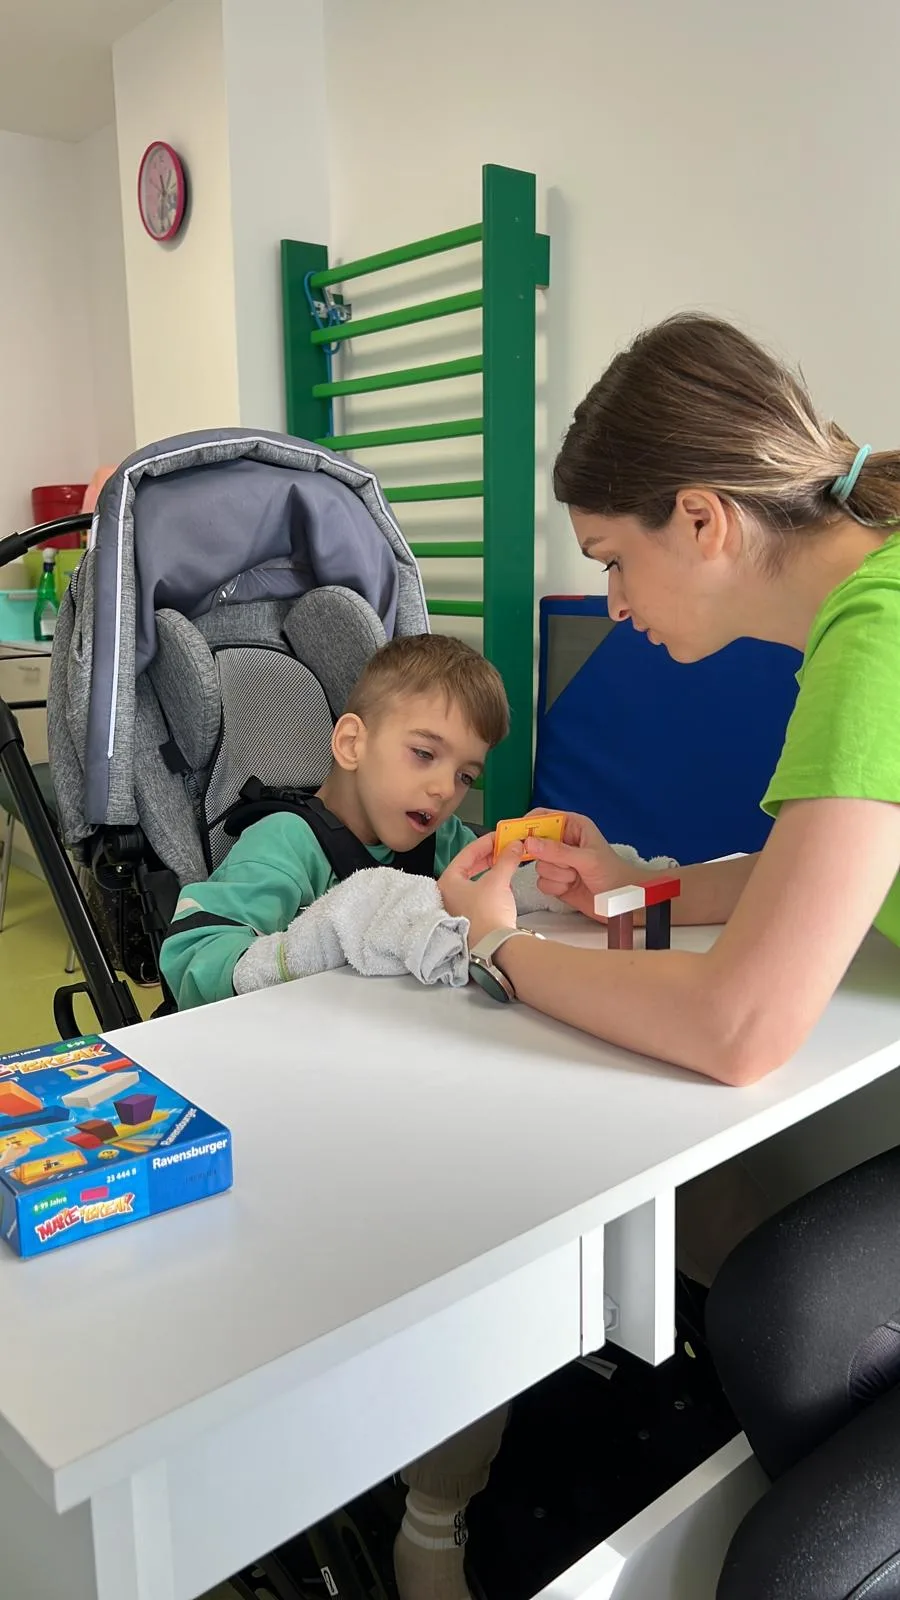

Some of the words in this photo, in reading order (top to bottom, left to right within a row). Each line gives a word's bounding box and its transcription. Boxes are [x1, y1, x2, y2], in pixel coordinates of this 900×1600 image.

[153, 1139, 228, 1170] Ravensburger
[50, 1196, 67, 1208] Jahre
[35, 1205, 81, 1242] MAKE
